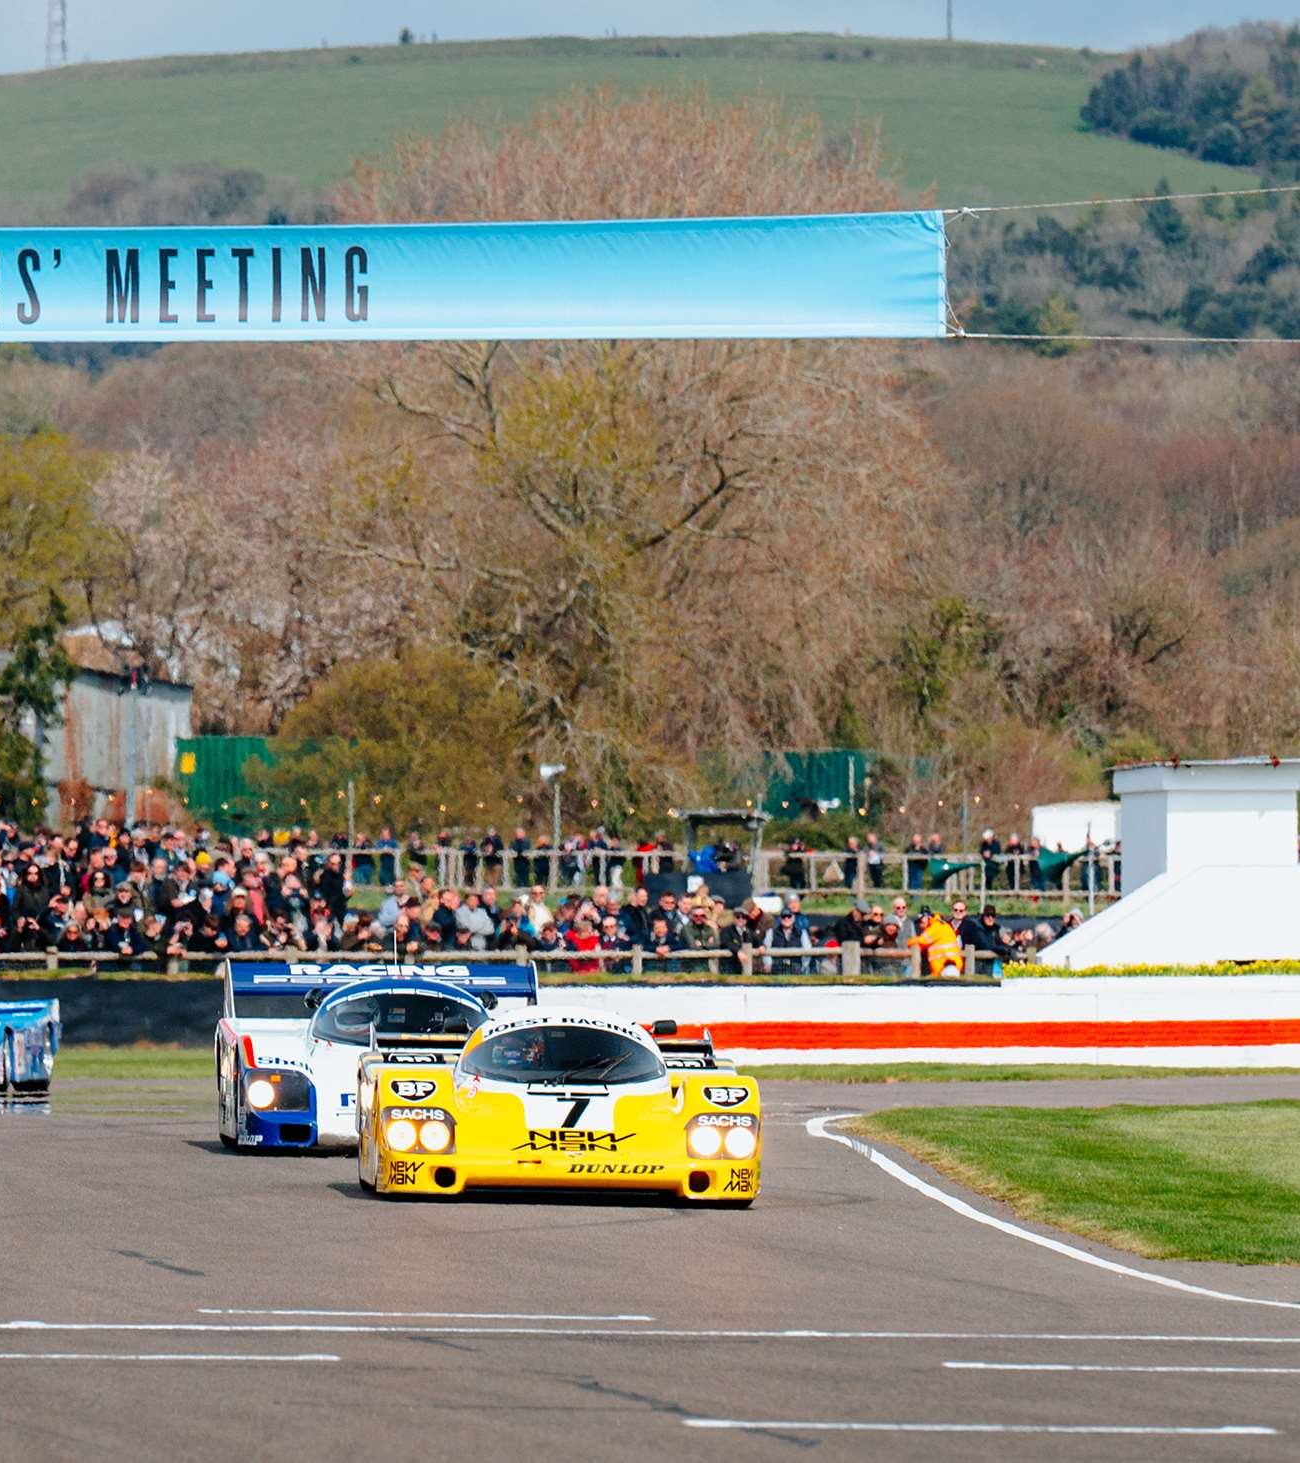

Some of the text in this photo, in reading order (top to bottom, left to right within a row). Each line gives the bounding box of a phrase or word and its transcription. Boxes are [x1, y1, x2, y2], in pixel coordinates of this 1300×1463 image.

[106, 245, 370, 325] MEETING
[288, 963, 470, 977] RACING
[484, 1017, 642, 1041] JOEST RACING
[396, 1081, 435, 1097] BP
[708, 1088, 747, 1103] BP
[391, 1108, 445, 1120] SACHS
[556, 1097, 591, 1128] 7
[697, 1115, 752, 1127] SACHS
[567, 1163, 665, 1174] DUNLOP
